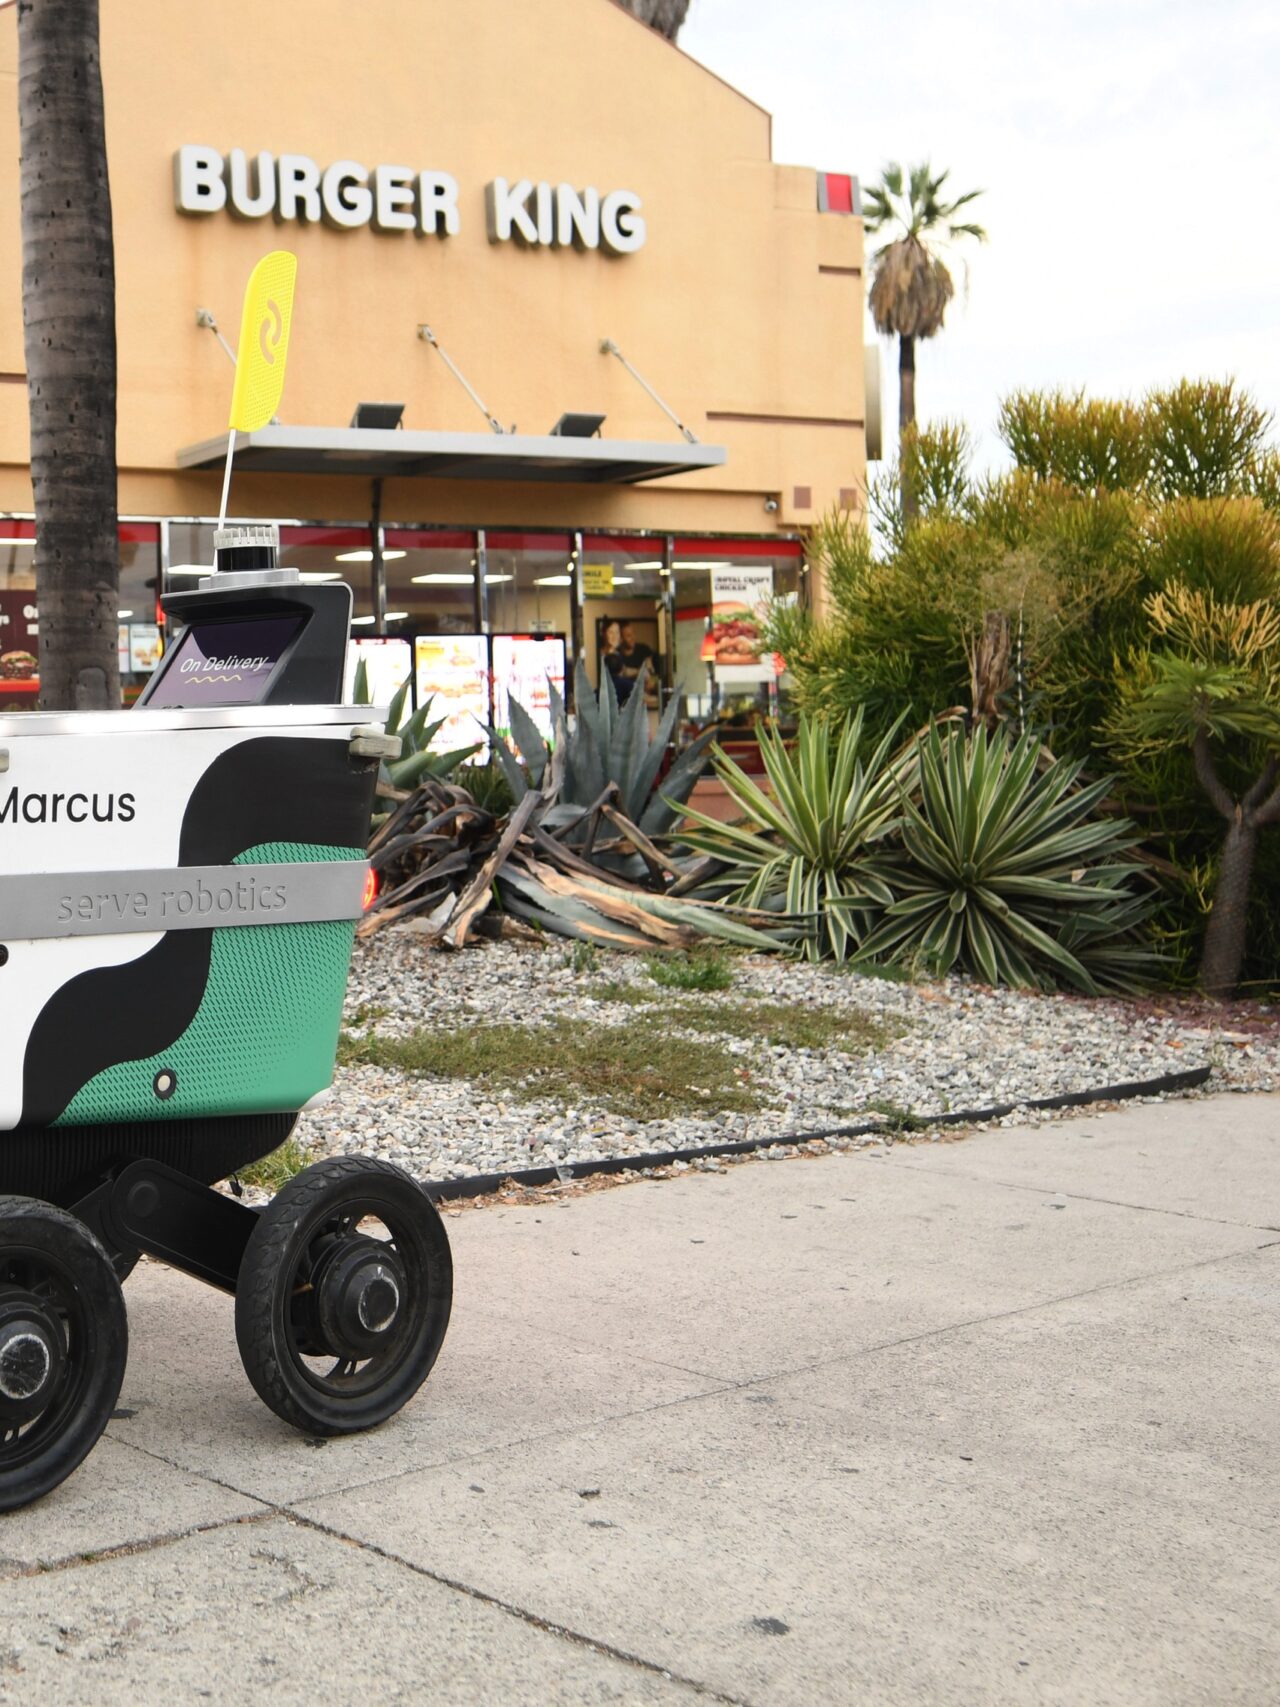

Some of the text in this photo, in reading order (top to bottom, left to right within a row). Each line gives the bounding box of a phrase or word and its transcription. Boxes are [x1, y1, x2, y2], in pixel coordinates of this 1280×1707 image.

[173, 143, 647, 256] BURGER KING
[180, 655, 269, 673] On Delivery
[57, 877, 287, 922] serve robotics
